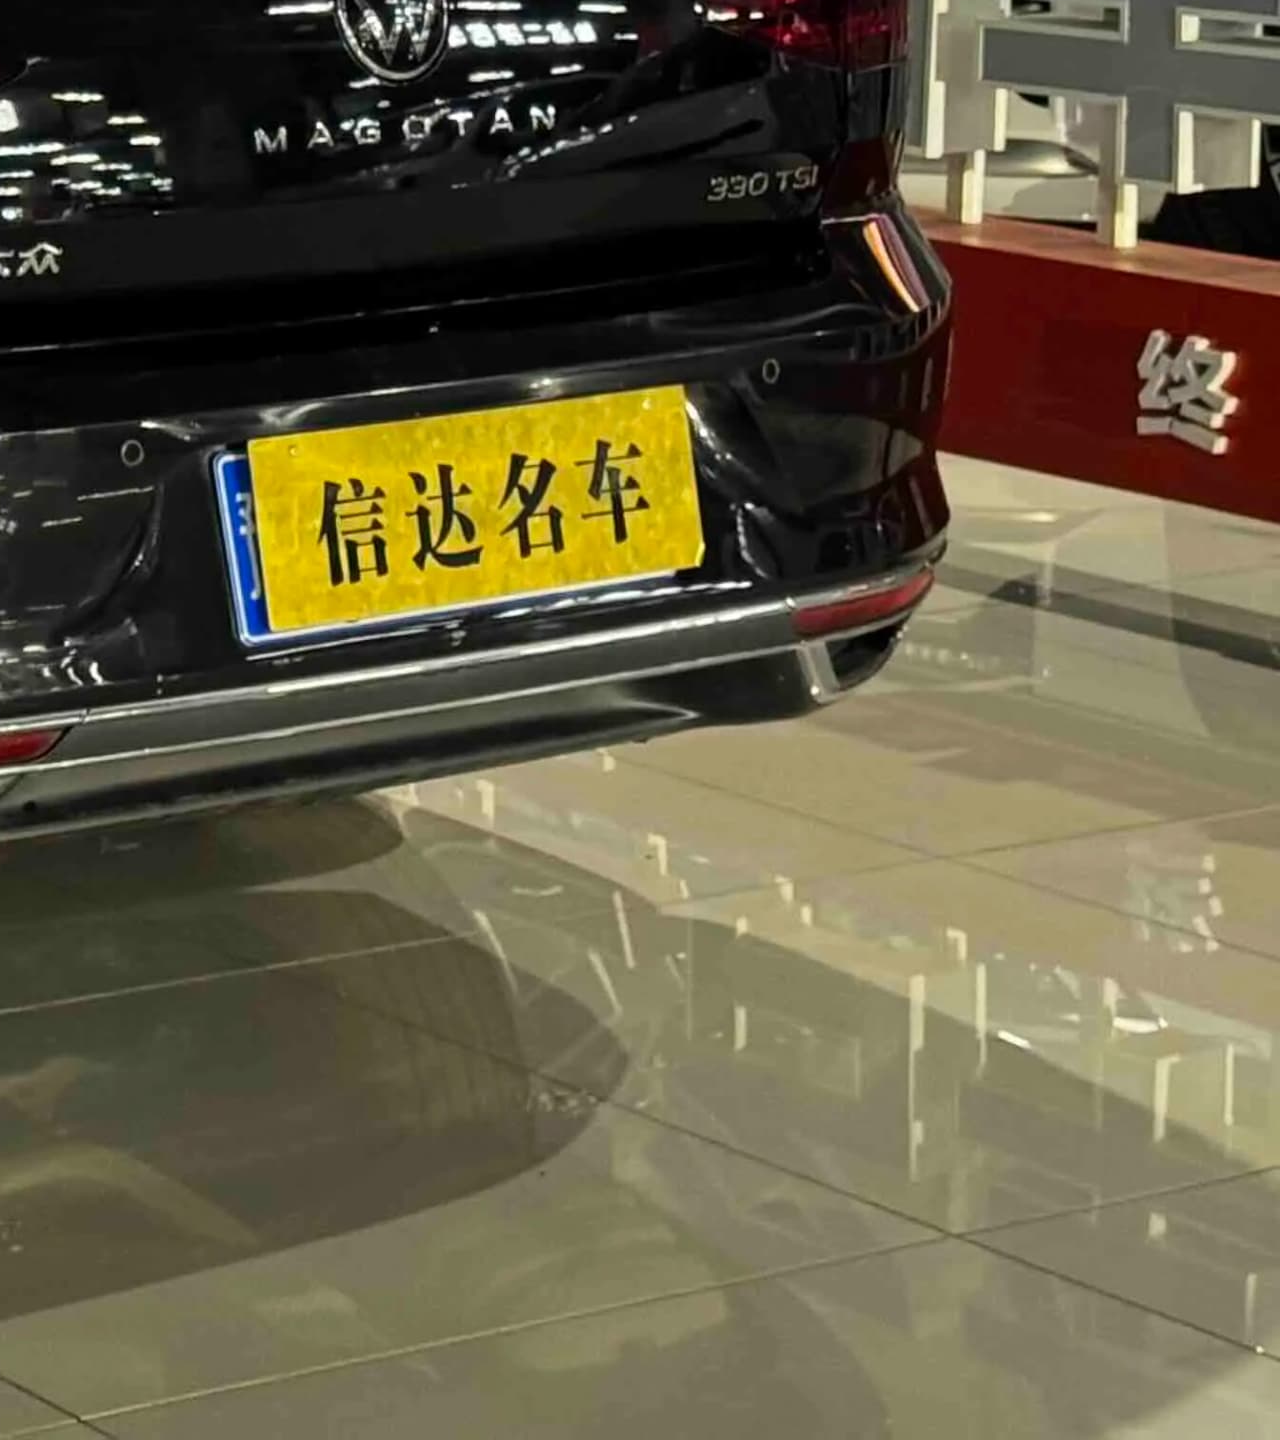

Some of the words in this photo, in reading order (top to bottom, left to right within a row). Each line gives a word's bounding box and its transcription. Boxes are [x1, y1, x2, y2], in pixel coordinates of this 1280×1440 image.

[252, 105, 556, 153] MAGOTAN
[706, 171, 770, 201] 330
[775, 164, 819, 192] TSI
[317, 438, 650, 587] 信达名车
